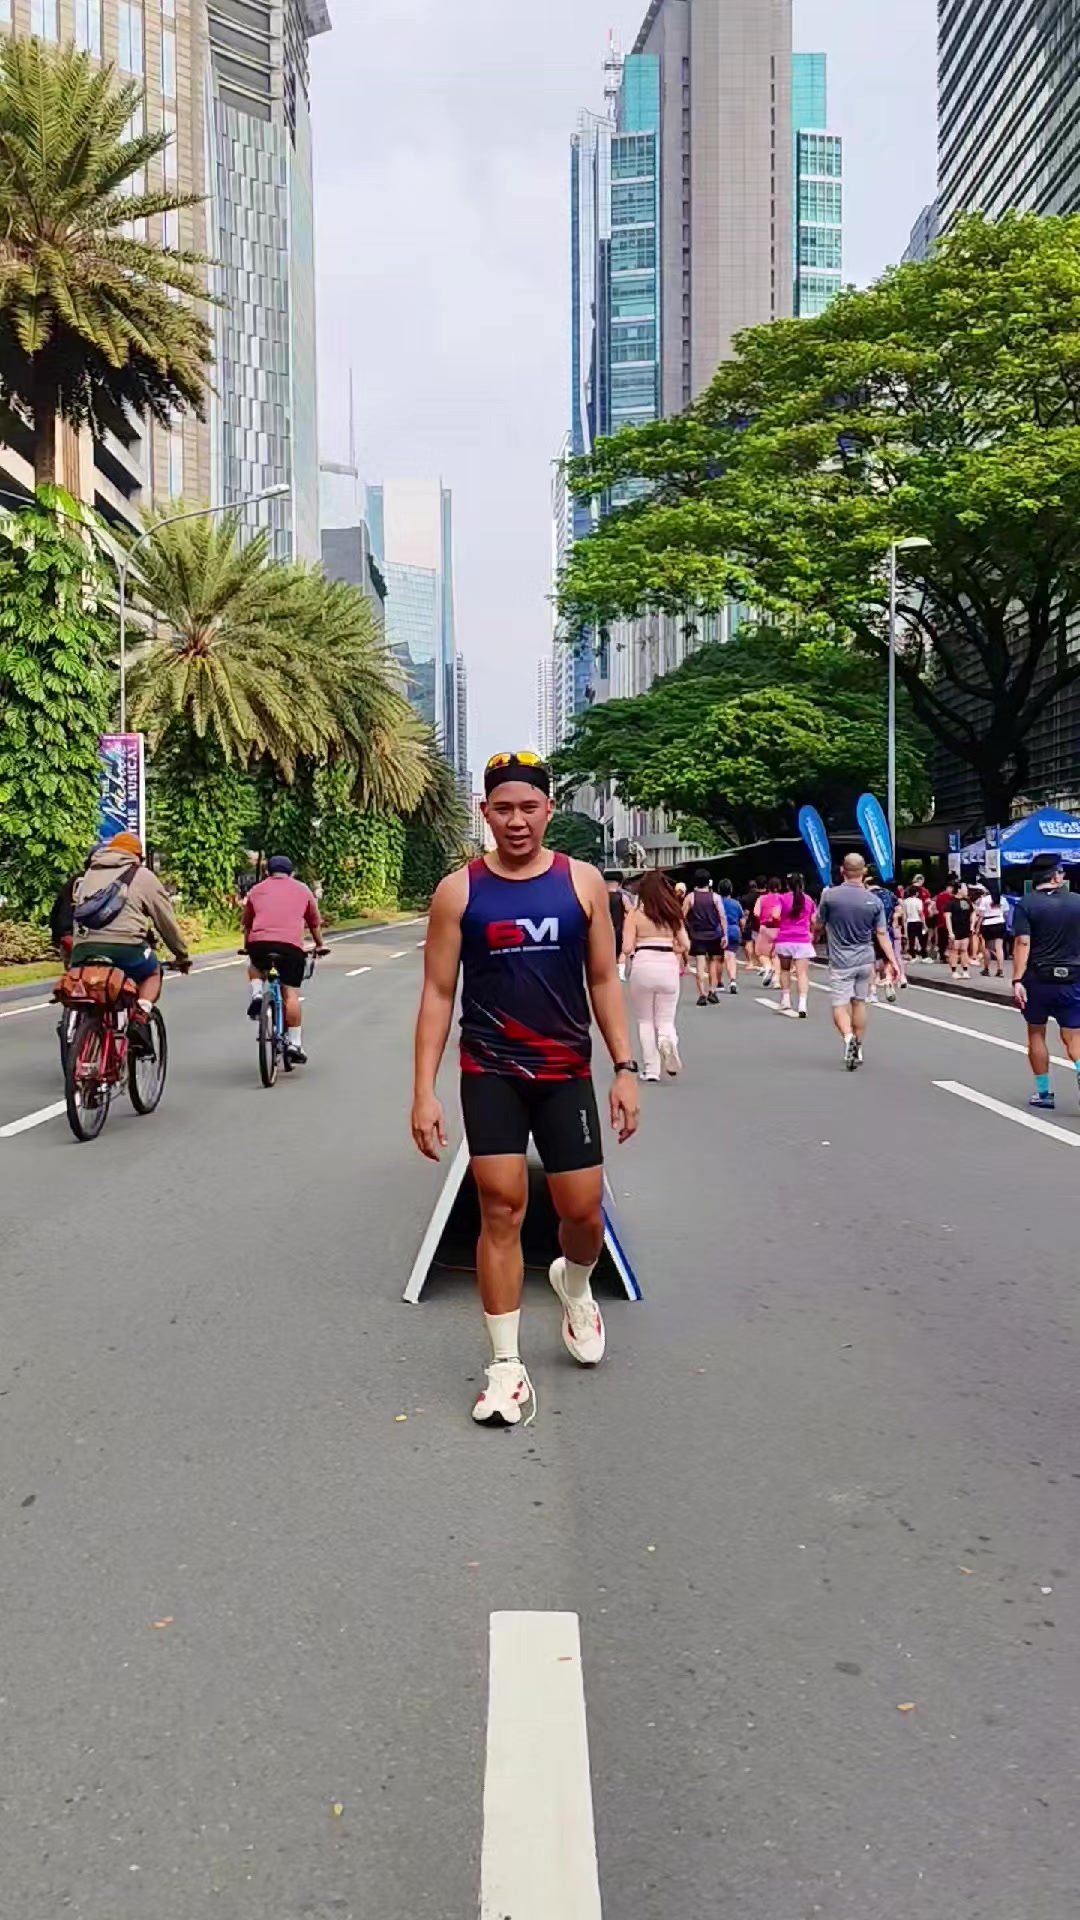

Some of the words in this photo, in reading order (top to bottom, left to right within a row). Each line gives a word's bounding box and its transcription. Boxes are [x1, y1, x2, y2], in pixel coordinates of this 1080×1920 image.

[102, 744, 127, 829] Notebook
[127, 741, 137, 801] MUSICAL
[127, 808, 137, 833] THE
